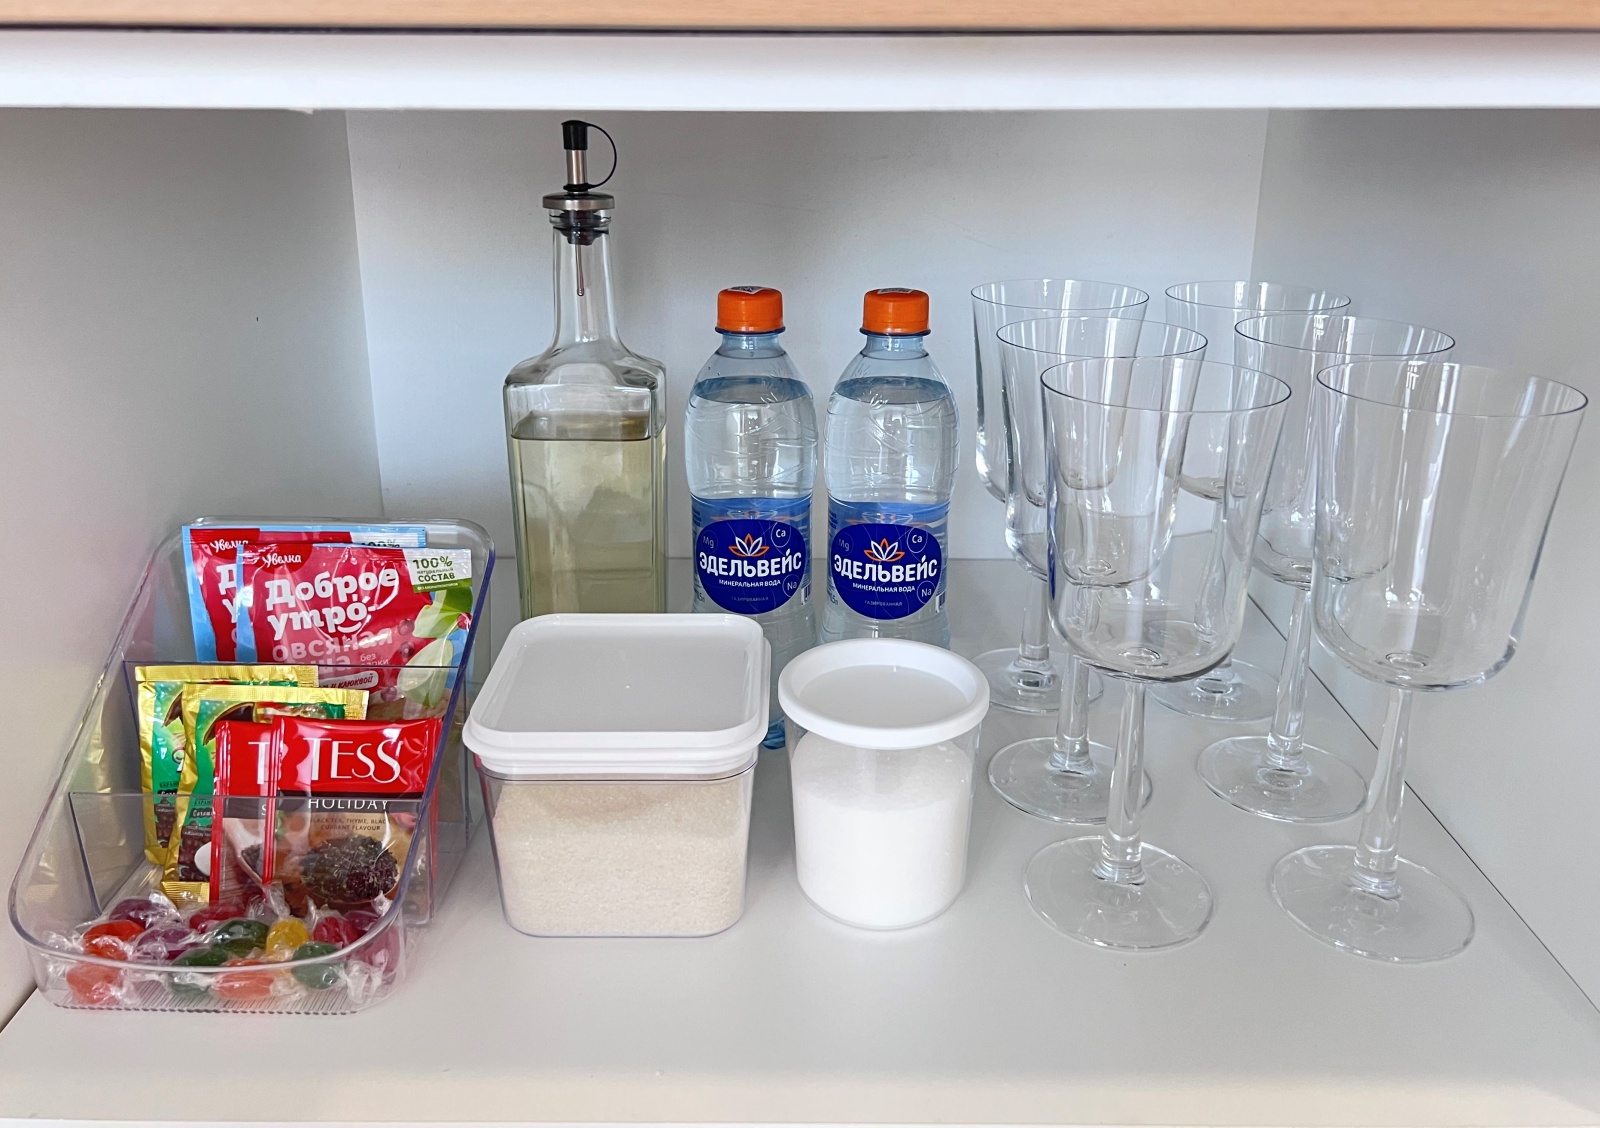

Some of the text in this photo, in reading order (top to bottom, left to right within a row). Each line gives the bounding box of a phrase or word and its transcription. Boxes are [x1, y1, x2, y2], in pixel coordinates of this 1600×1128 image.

[775, 528, 787, 538] Ca
[911, 534, 923, 544] Ca
[702, 536, 715, 549] Mg
[838, 538, 850, 552] Mg
[262, 553, 302, 567] Увелка
[412, 556, 453, 569] 100%
[699, 548, 802, 578] ЭДЕЛЬВЕЙС
[833, 555, 938, 583] ЭДЕЛЬВЕЙС
[418, 573, 455, 582] СОСТАВ
[718, 578, 781, 588] МИНЕРАЛЬНАЯ ВОДА
[265, 568, 399, 611] Доброе
[787, 581, 798, 591] Na
[852, 582, 916, 593] МИНЕРАЛЬНАЯ ВОДА
[921, 588, 932, 598] Na
[267, 602, 367, 641] утро
[360, 653, 376, 662] без
[303, 737, 404, 783] TESS
[307, 798, 388, 809] HOLIDAY
